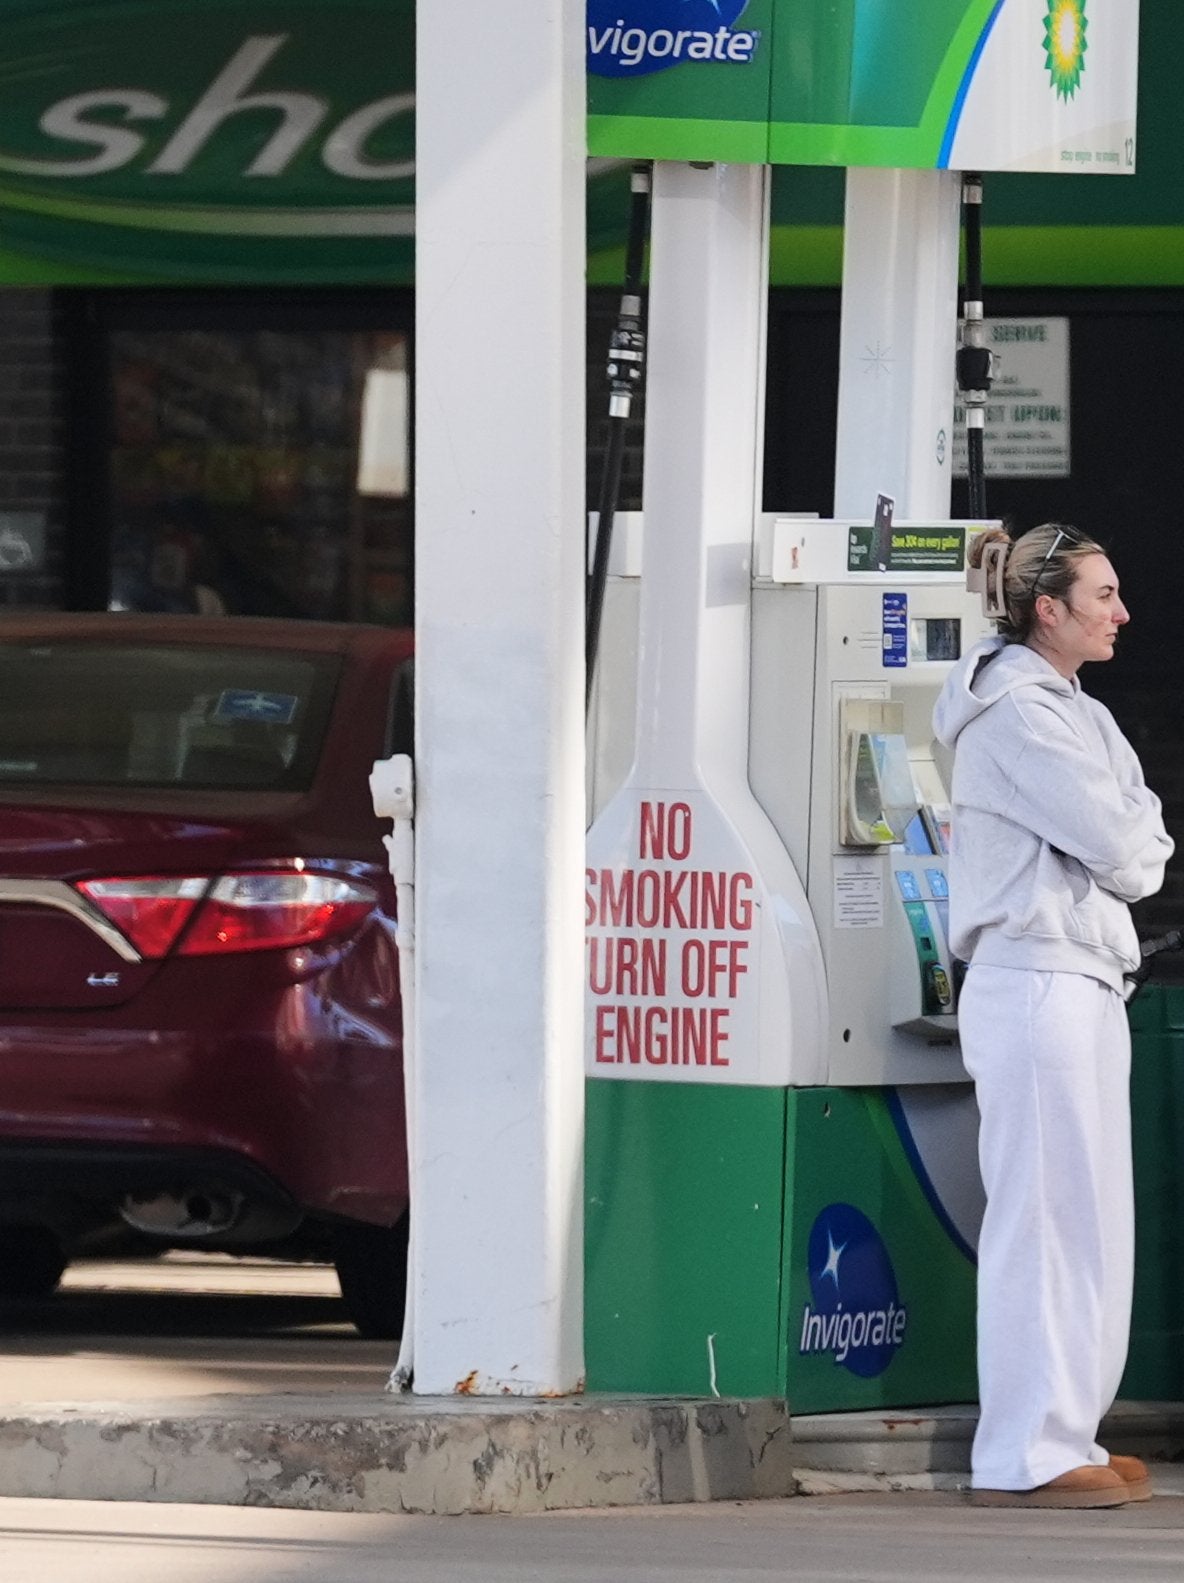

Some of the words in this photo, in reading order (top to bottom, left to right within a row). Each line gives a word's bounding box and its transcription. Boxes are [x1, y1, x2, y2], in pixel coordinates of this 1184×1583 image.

[589, 19, 754, 66] vigorate
[639, 801, 692, 861] NO
[585, 936, 667, 997] URN
[681, 939, 749, 998] OFF
[595, 1005, 730, 1066] ENGINE
[800, 1302, 906, 1362] Invigorate
